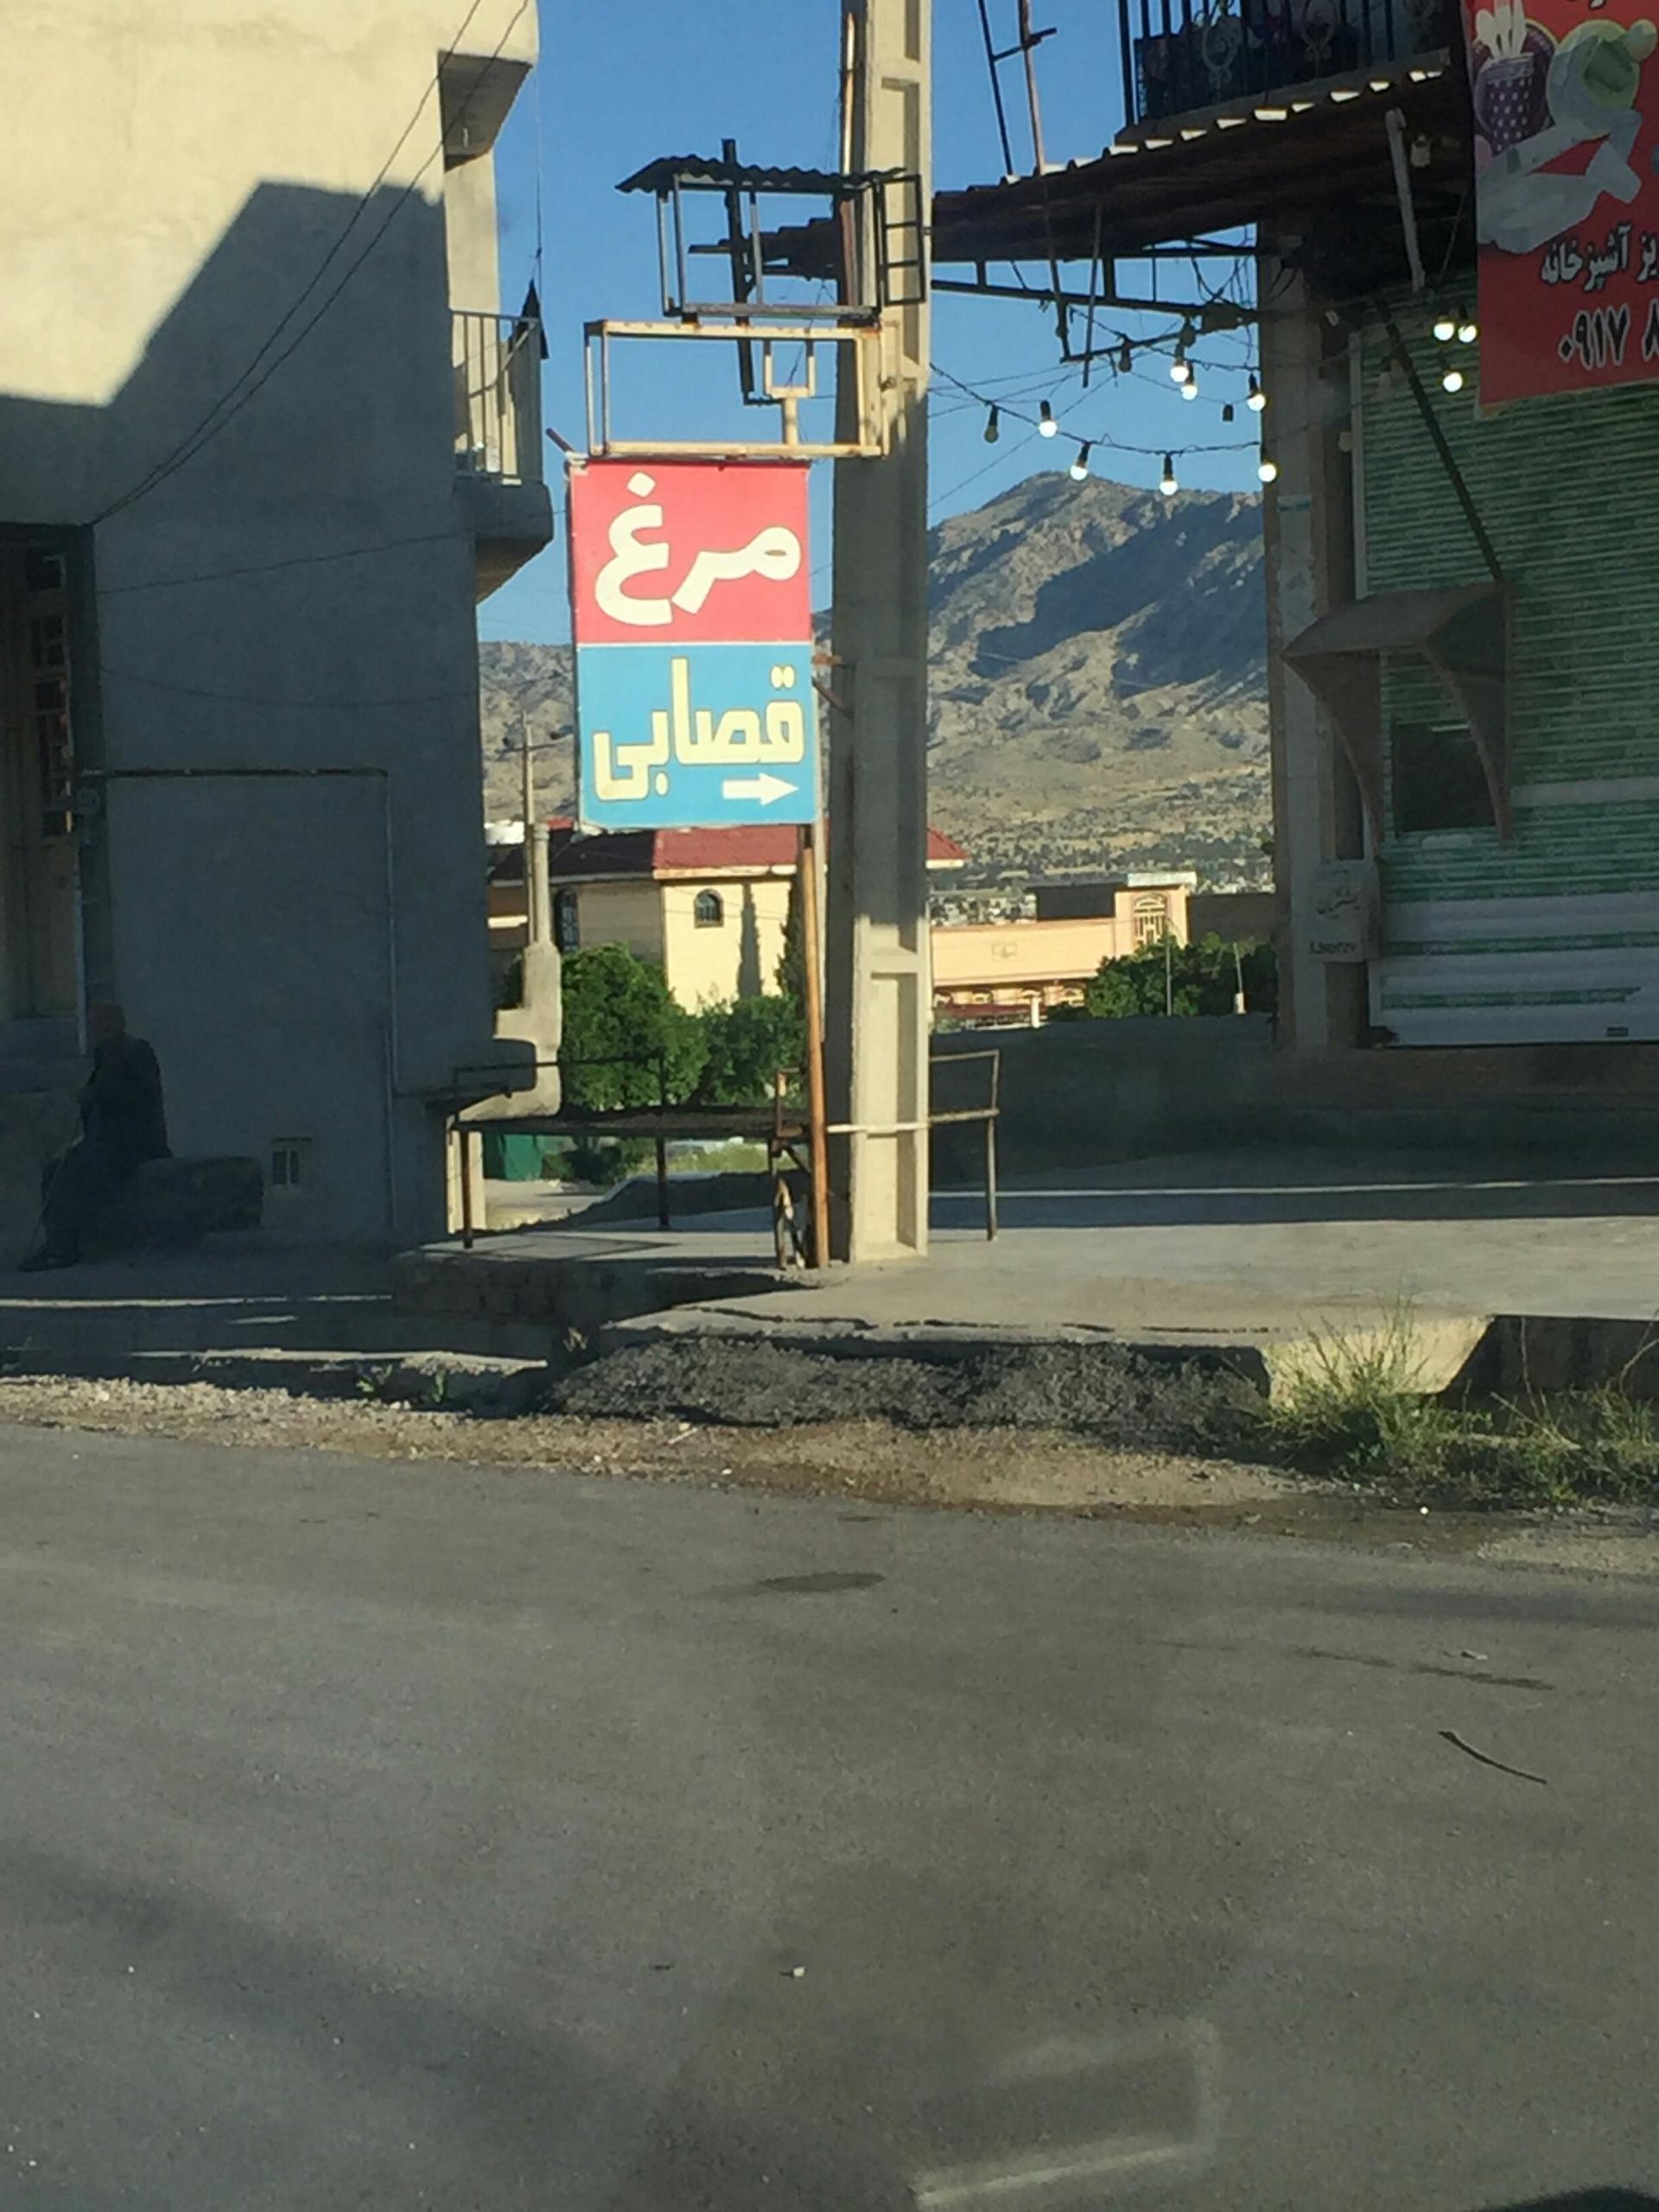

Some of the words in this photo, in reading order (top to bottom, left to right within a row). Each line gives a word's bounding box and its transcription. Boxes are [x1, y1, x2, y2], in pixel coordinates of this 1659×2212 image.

[1541, 225, 1631, 291] آشپزخانه
[1558, 303, 1630, 370] ۰۹۱۷
[594, 472, 802, 626] مرغ
[594, 656, 804, 801] قصابی
